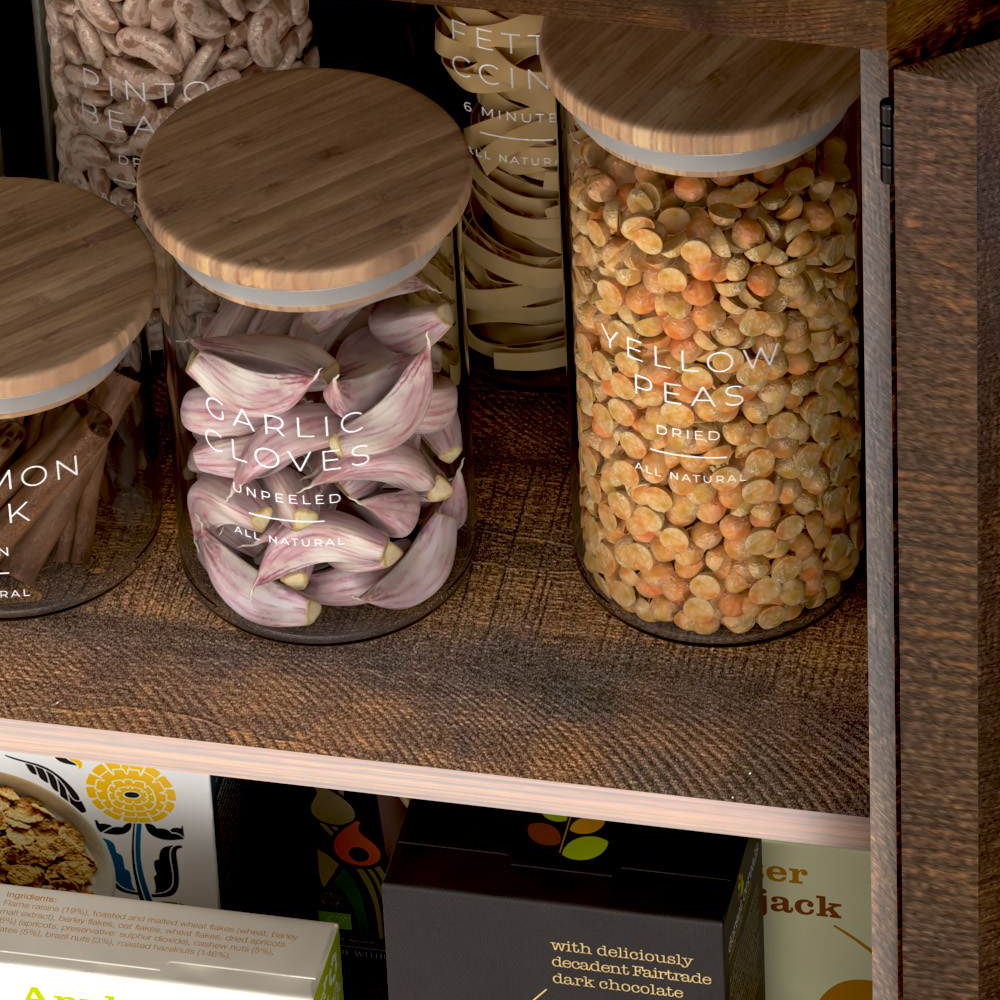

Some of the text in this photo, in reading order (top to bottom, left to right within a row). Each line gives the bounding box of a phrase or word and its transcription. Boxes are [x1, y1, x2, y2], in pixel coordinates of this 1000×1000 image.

[451, 18, 540, 55] FETT
[82, 67, 210, 104] PINTO
[463, 101, 473, 113] 6
[601, 323, 780, 373] YELLOW
[634, 373, 745, 408] PEAS
[205, 396, 364, 437] GARLIC
[656, 424, 721, 442] DRIED
[204, 428, 371, 472] CLOVES
[635, 462, 748, 484] ALL NATURAL
[232, 481, 342, 505] UNPEELED
[234, 526, 346, 547] ALL NATURAL
[762, 888, 842, 919] jack
[2, 899, 30, 909] Flame
[31, 902, 60, 912] raisins
[93, 910, 126, 920] toasted
[128, 914, 146, 922] and
[147, 917, 178, 926] malted
[180, 920, 207, 930] wheat
[209, 923, 235, 933] flakes
[271, 930, 299, 942] barley
[58, 915, 85, 926] barley
[118, 922, 133, 930] oat
[165, 927, 192, 937] wheat
[225, 935, 248, 944] dried
[250, 938, 286, 949] apricots
[70, 935, 90, 943] nuts
[117, 940, 151, 950] roasted
[119, 930, 153, 941] sulphur
[193, 940, 227, 950] cashew
[229, 944, 250, 953] nuts
[550, 940, 694, 969] with deliciously
[551, 956, 712, 985] decadent Fairtrade
[552, 972, 684, 999] dark chocolate
